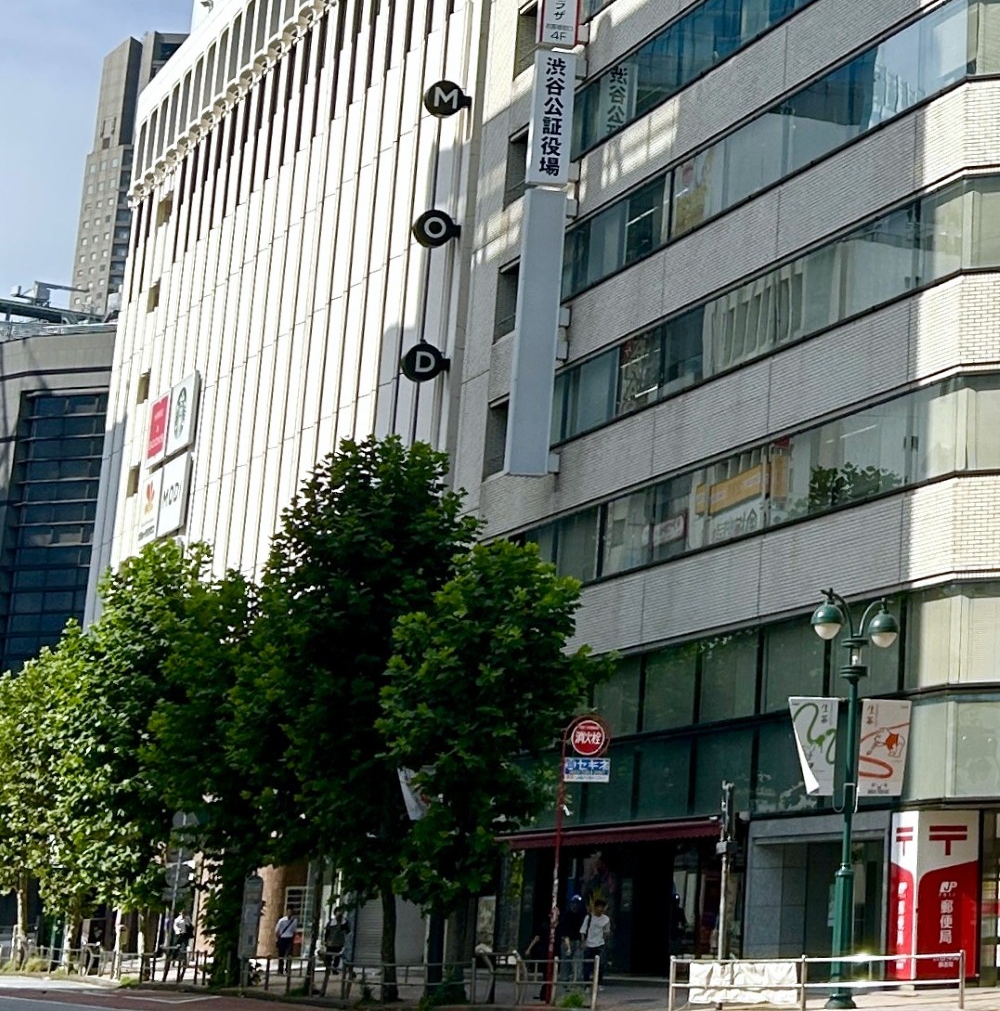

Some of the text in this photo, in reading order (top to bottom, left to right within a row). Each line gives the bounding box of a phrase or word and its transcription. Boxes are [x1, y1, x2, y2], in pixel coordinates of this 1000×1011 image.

[550, 31, 567, 41] 4F
[539, 56, 566, 177] 渋谷公証役場
[575, 731, 602, 745] 消火栓
[938, 899, 954, 945] 郵便局
